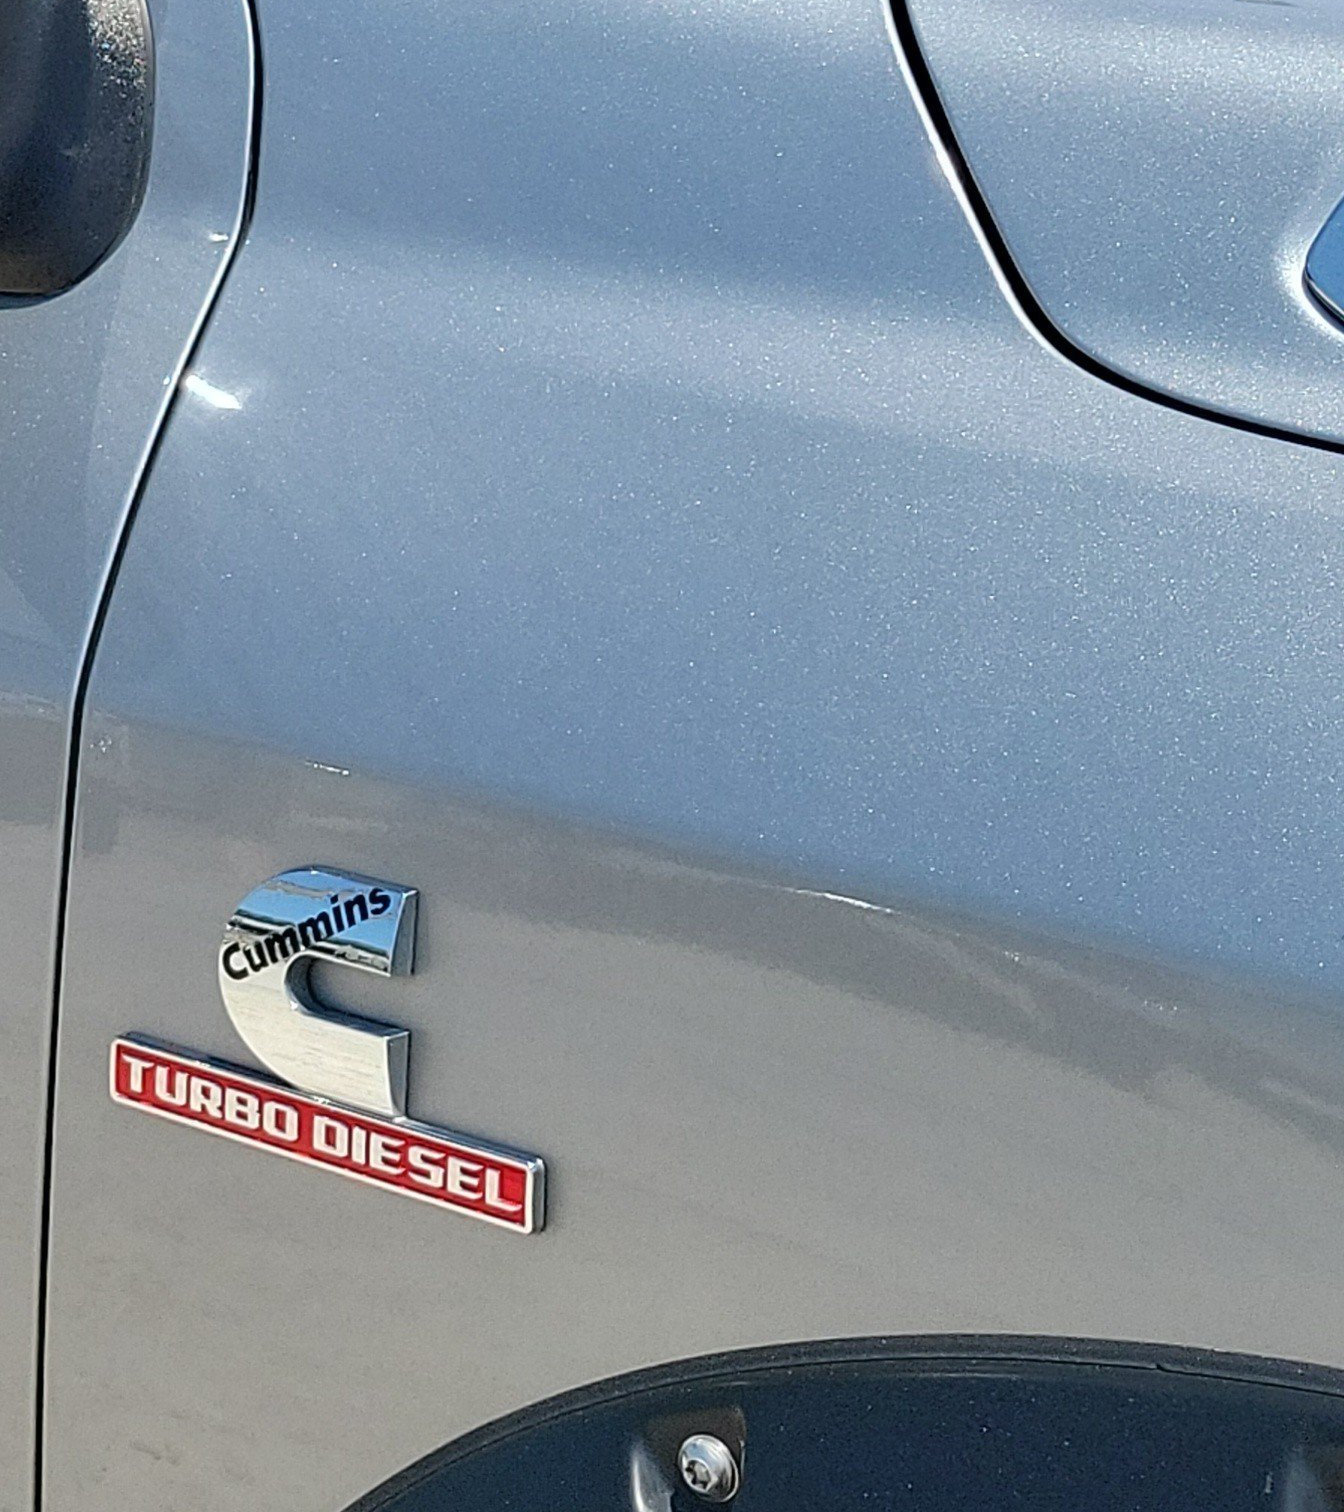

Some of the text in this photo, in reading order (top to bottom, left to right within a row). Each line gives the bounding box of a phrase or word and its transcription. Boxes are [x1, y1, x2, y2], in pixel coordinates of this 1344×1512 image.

[223, 887, 392, 980] Cummins
[120, 1053, 523, 1212] TURBO DIESEL
